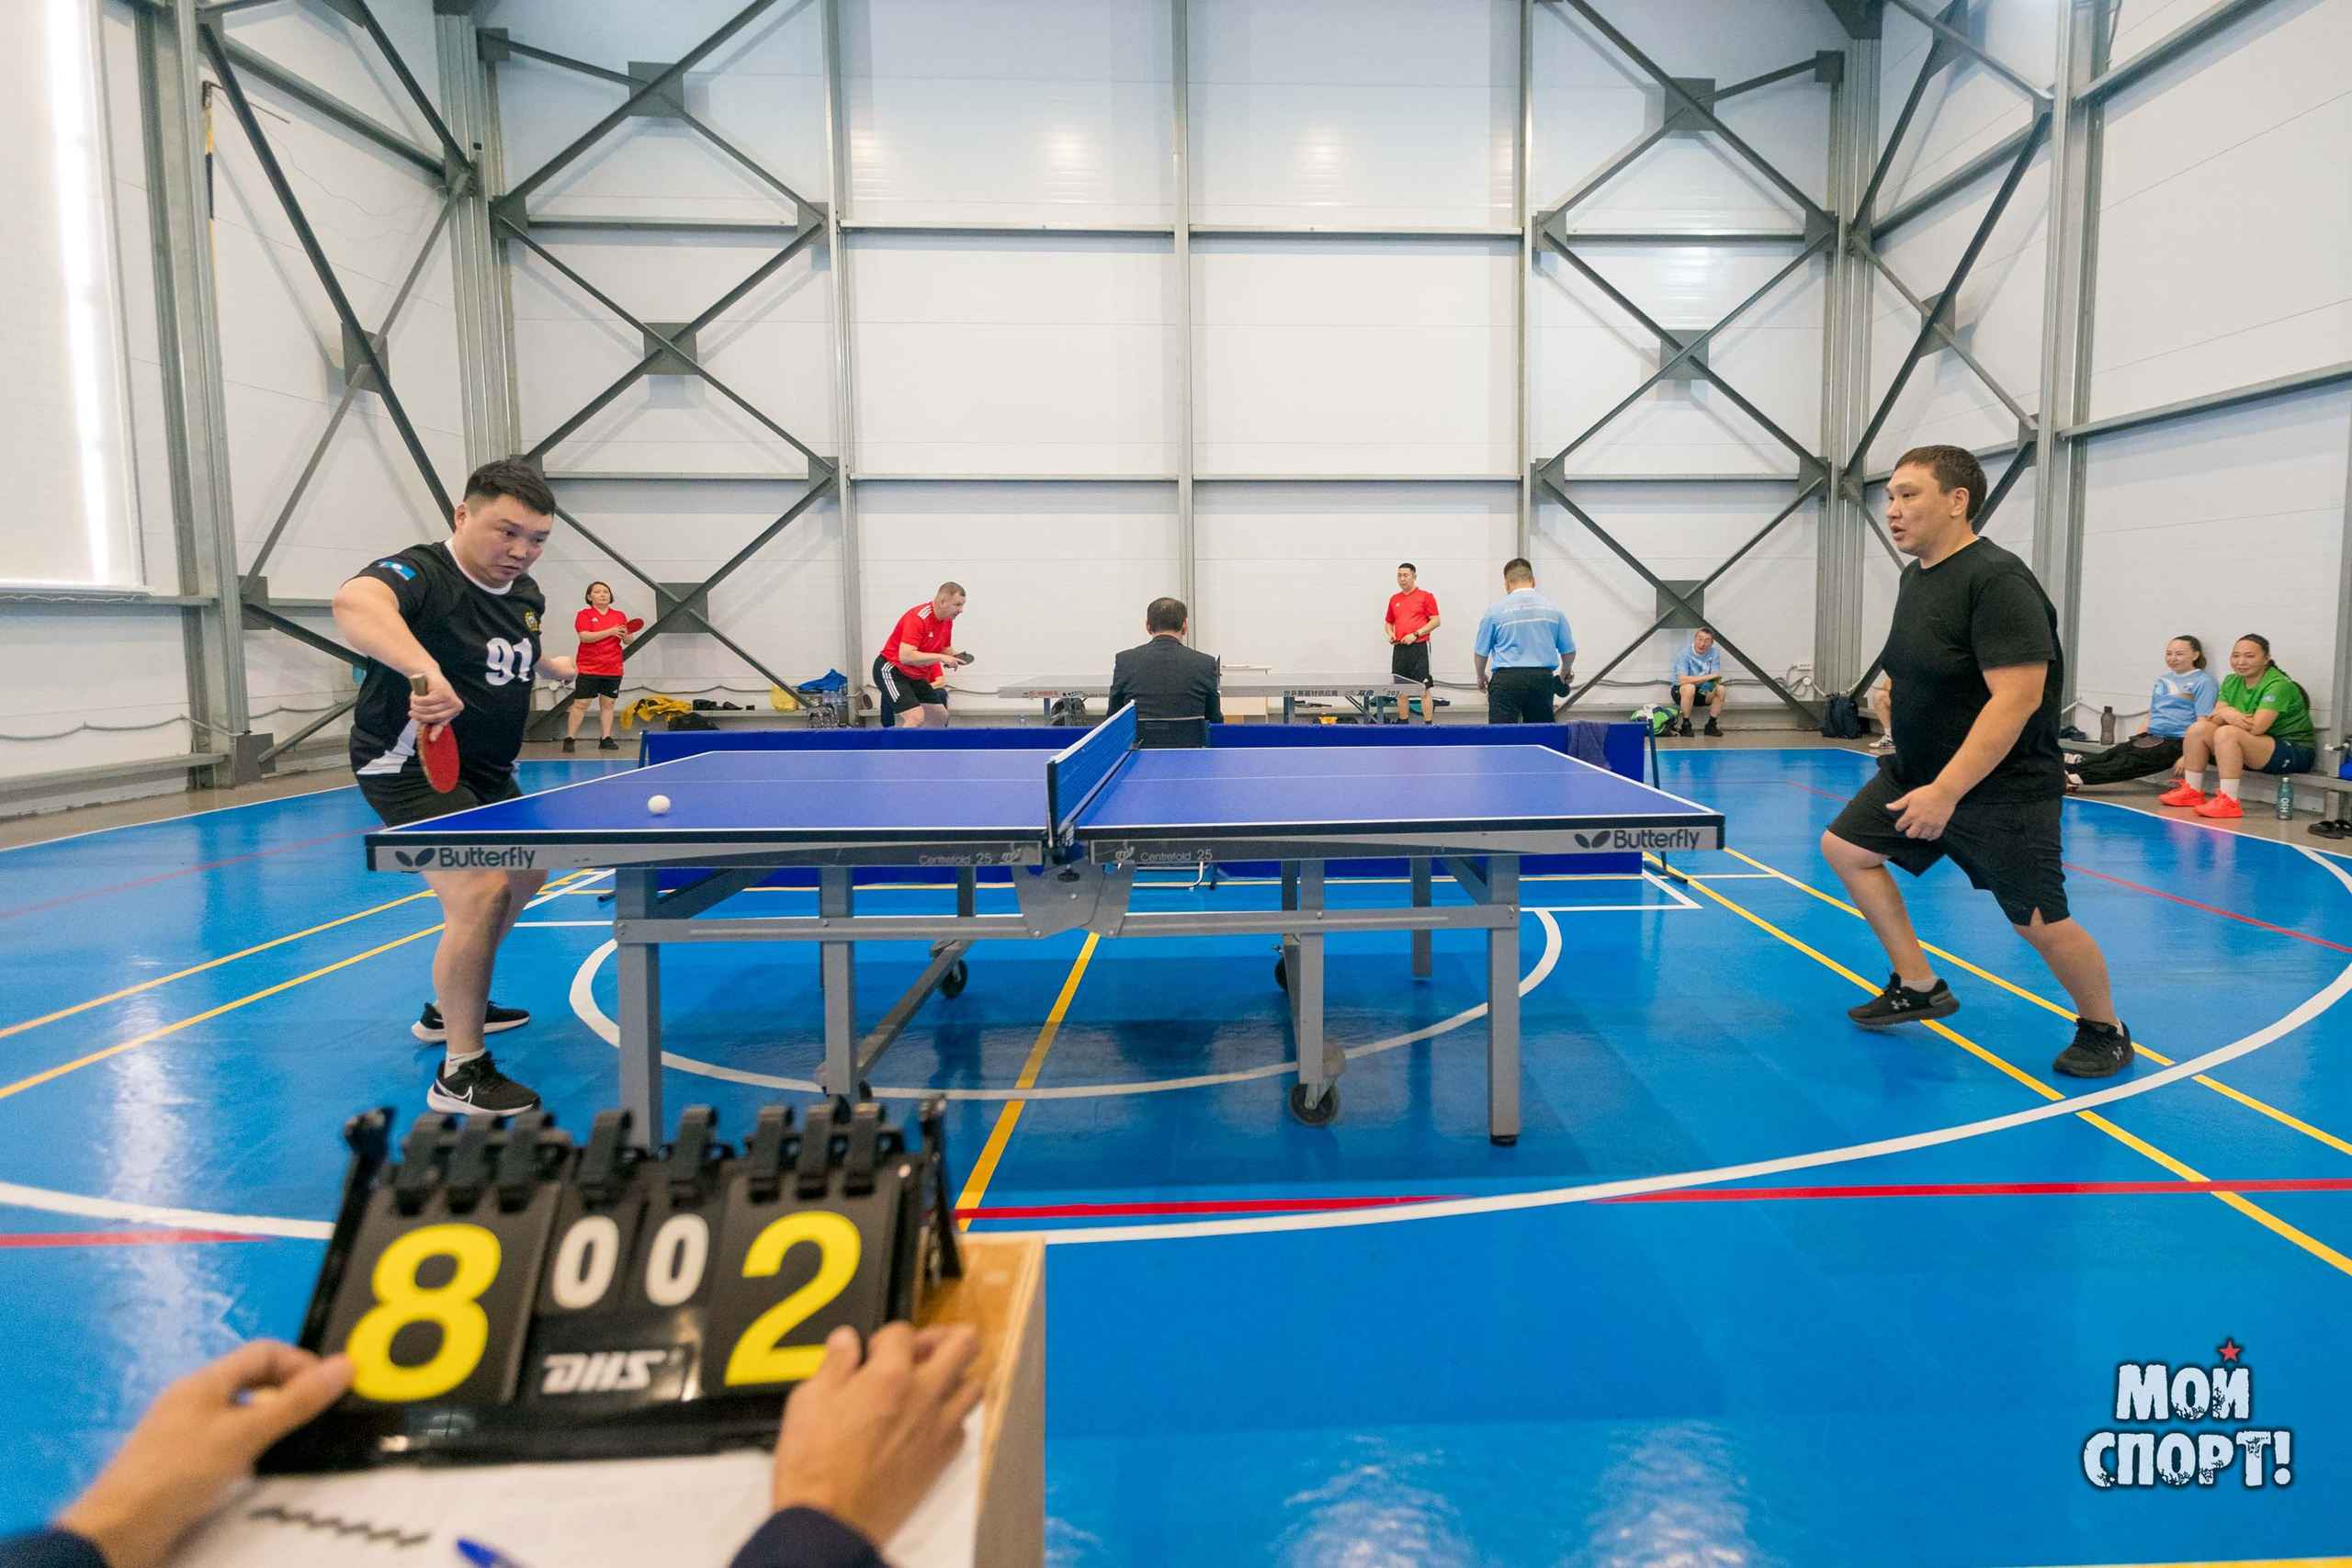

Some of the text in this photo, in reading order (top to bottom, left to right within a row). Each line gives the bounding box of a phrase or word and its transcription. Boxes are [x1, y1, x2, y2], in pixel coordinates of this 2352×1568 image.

[485, 637, 533, 686] 91
[1613, 829, 1701, 851] Butterfly
[439, 847, 536, 869] Butterfly
[919, 854, 971, 865] Centrefold
[976, 852, 993, 864] 25
[1139, 850, 1192, 863] Centrefold
[1196, 848, 1214, 861] 25
[345, 1210, 863, 1404] 8 0 0 2
[541, 1348, 669, 1394] DHS
